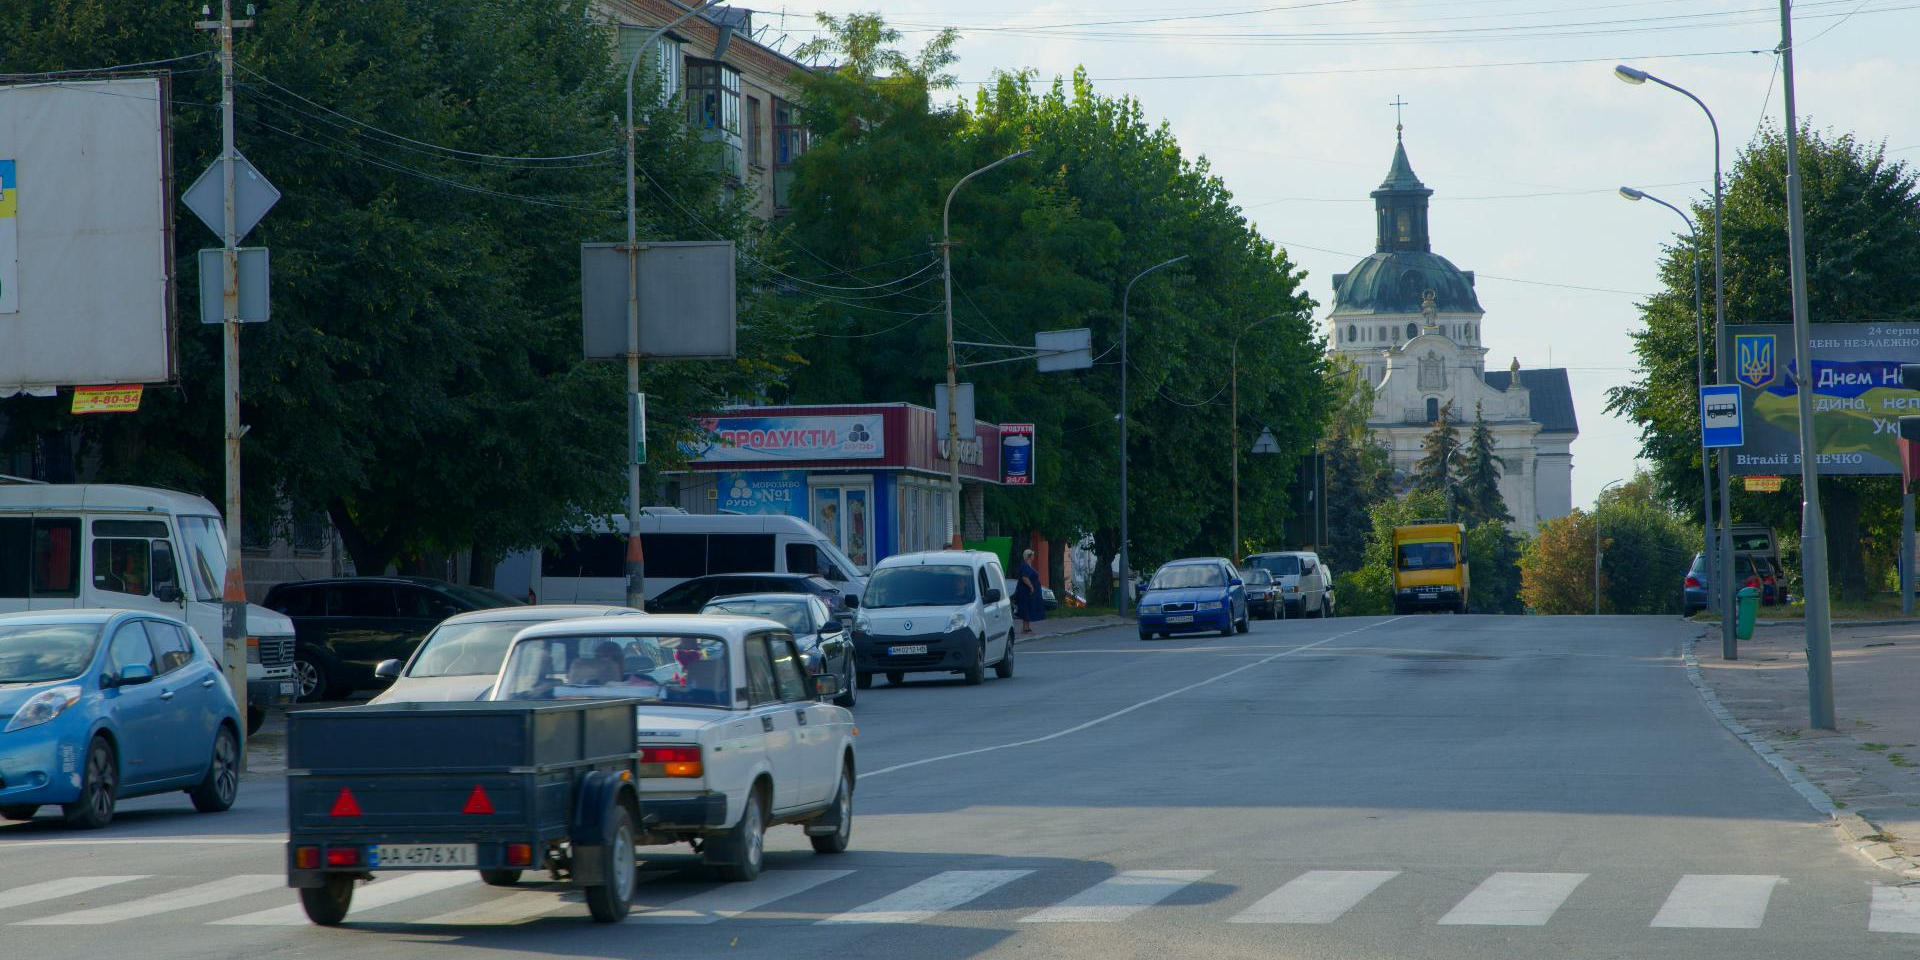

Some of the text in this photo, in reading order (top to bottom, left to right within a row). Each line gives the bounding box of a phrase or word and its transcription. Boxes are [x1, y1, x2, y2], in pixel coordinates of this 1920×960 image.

[1868, 327, 1882, 335] 24
[1809, 339, 1840, 349] ДЕНЬ
[1818, 367, 1872, 388] Днем
[1811, 397, 1872, 412] дина,
[720, 430, 837, 450] ПРОДУКТИ
[1737, 453, 1863, 465] Віталій БНЕЧКО
[751, 481, 800, 489] МОРОЗИВО
[1007, 476, 1026, 484] 24/7
[726, 499, 757, 507] РУДЬ
